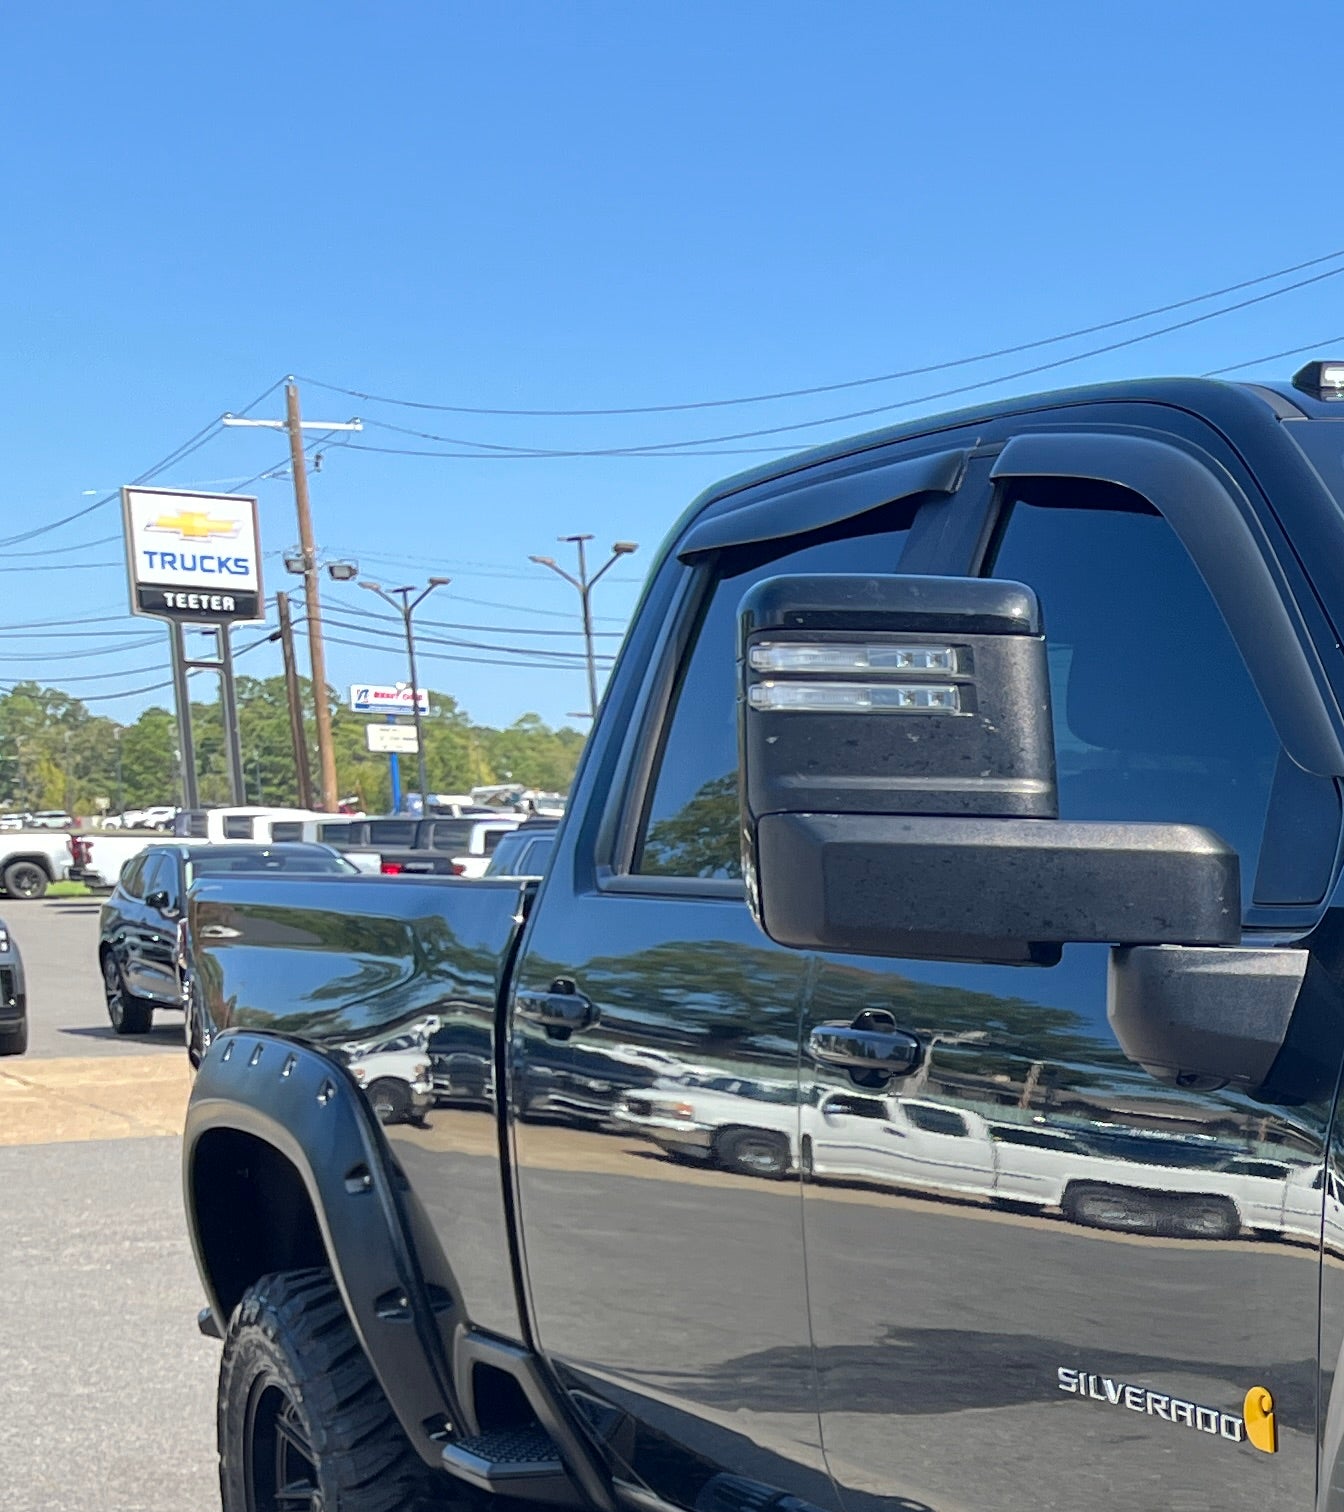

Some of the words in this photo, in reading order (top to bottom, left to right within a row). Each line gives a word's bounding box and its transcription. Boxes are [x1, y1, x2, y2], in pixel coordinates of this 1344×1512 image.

[143, 550, 249, 575] TRUCKS
[163, 592, 235, 612] TEETER
[1057, 1366, 1244, 1442] SILVERADO
